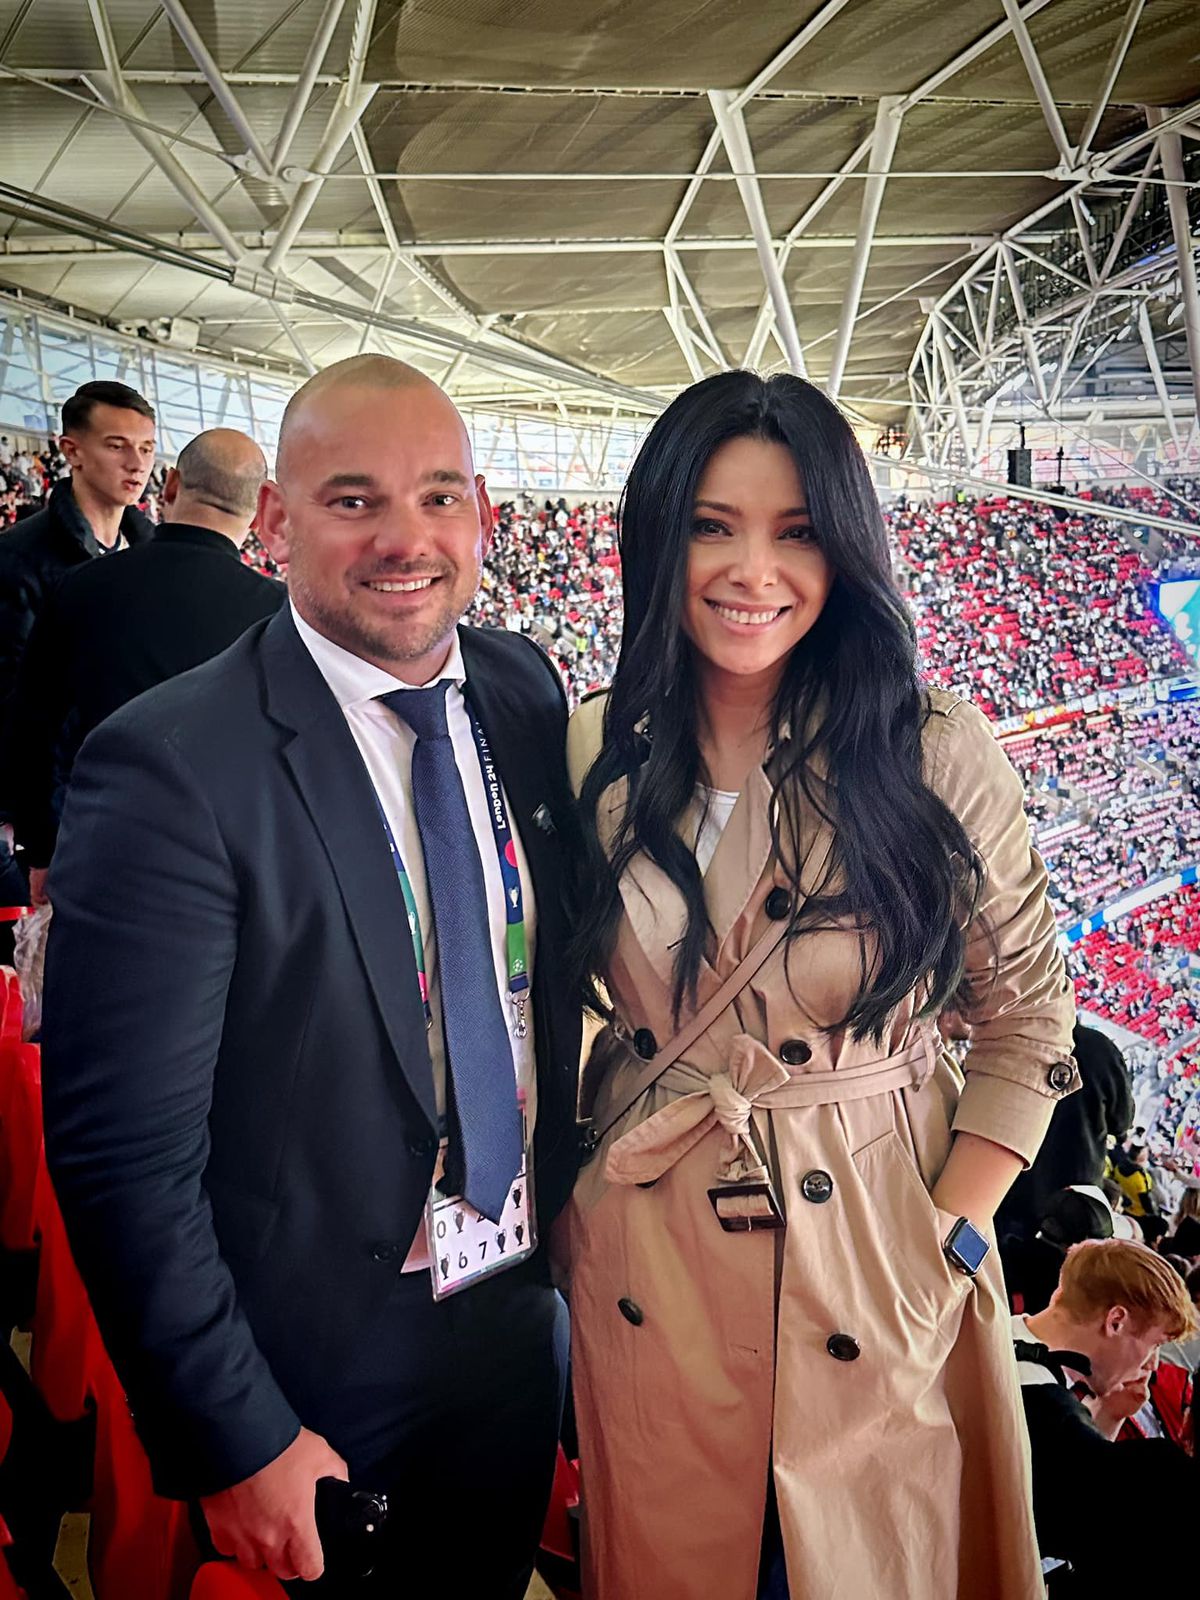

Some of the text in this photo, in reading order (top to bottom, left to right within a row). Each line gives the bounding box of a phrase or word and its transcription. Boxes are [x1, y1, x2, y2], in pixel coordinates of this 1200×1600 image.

[486, 764, 497, 781] 24
[436, 1220, 446, 1239] 0
[458, 1241, 488, 1269] 6 7
